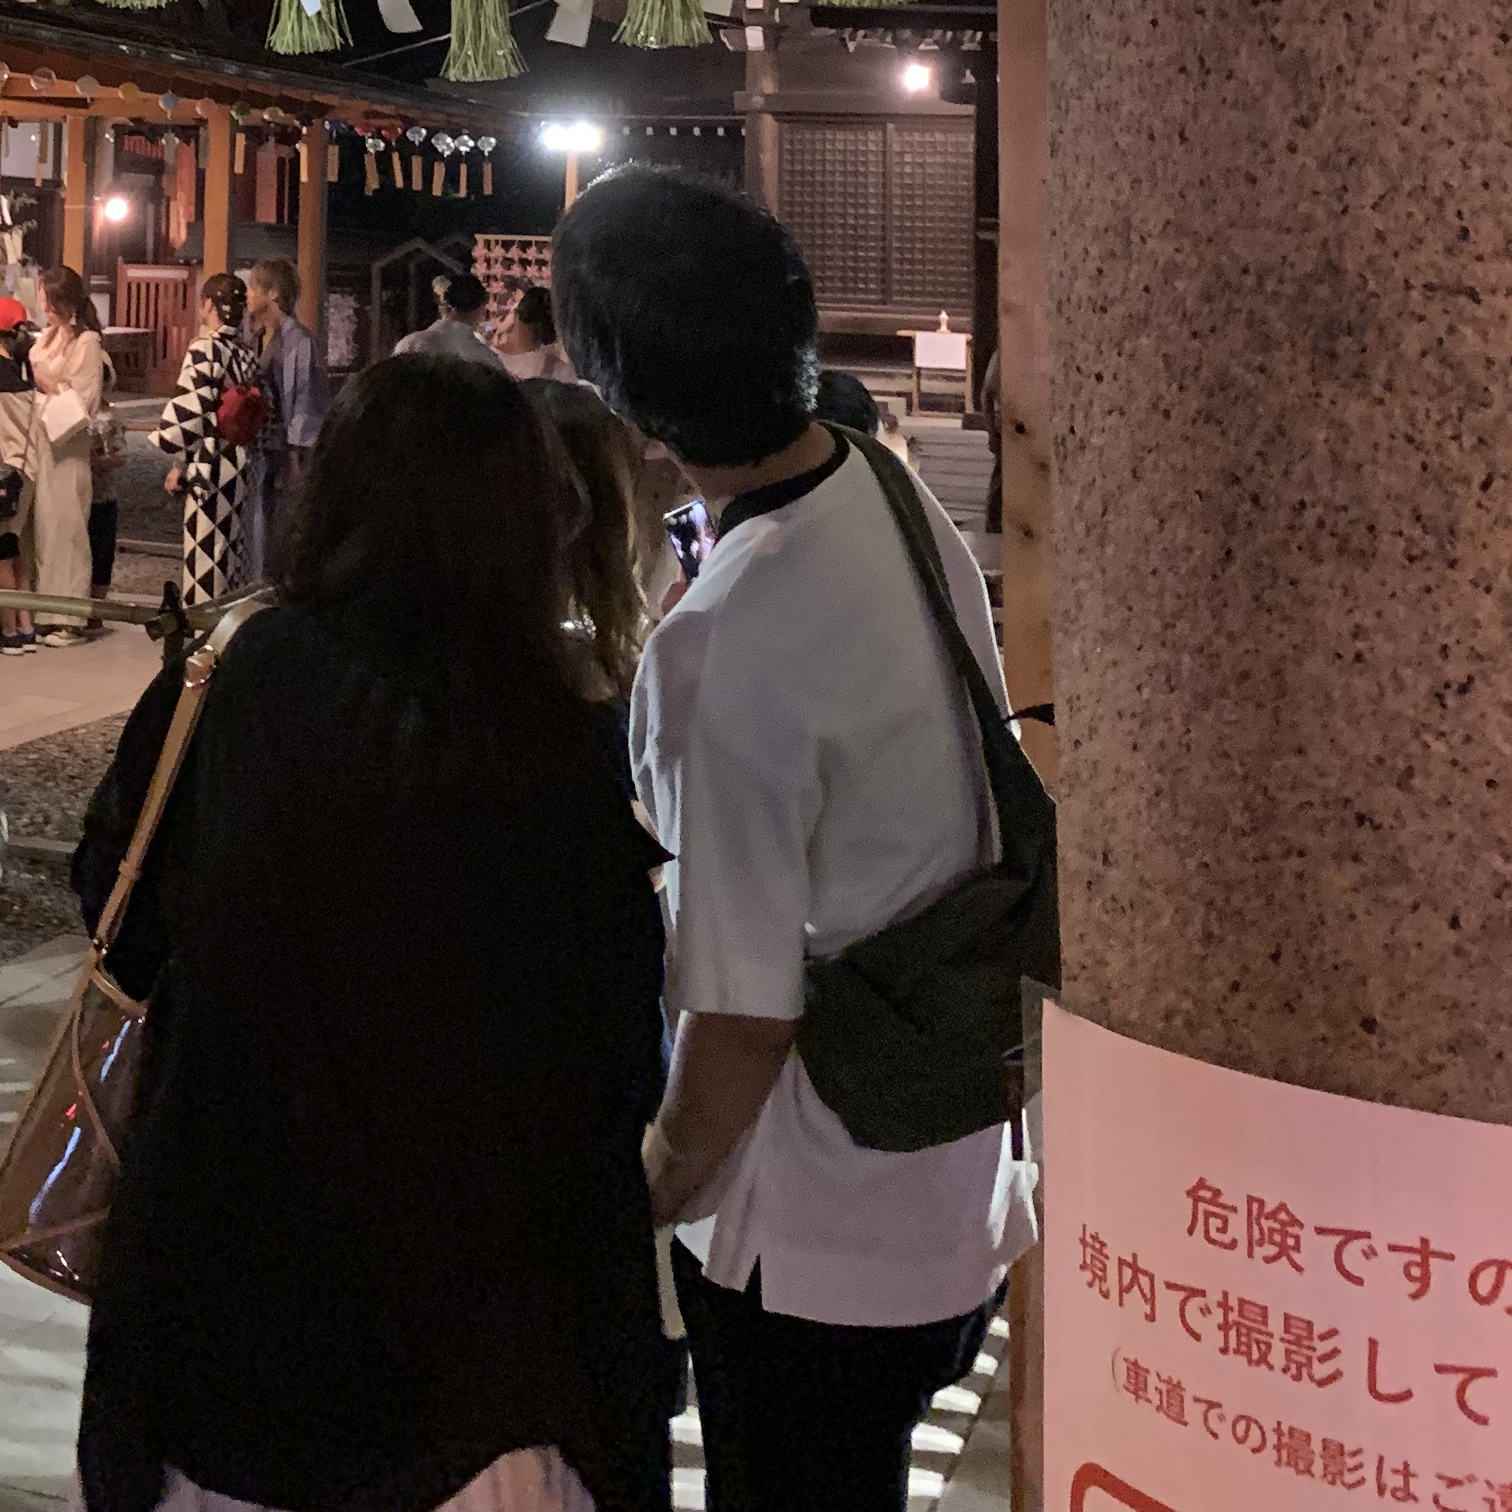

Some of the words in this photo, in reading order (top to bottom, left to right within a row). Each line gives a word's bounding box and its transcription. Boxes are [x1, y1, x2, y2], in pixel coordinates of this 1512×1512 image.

[1078, 1223, 1498, 1427] 境内で撮影して
[1185, 1176, 1512, 1316] 危険ですの
